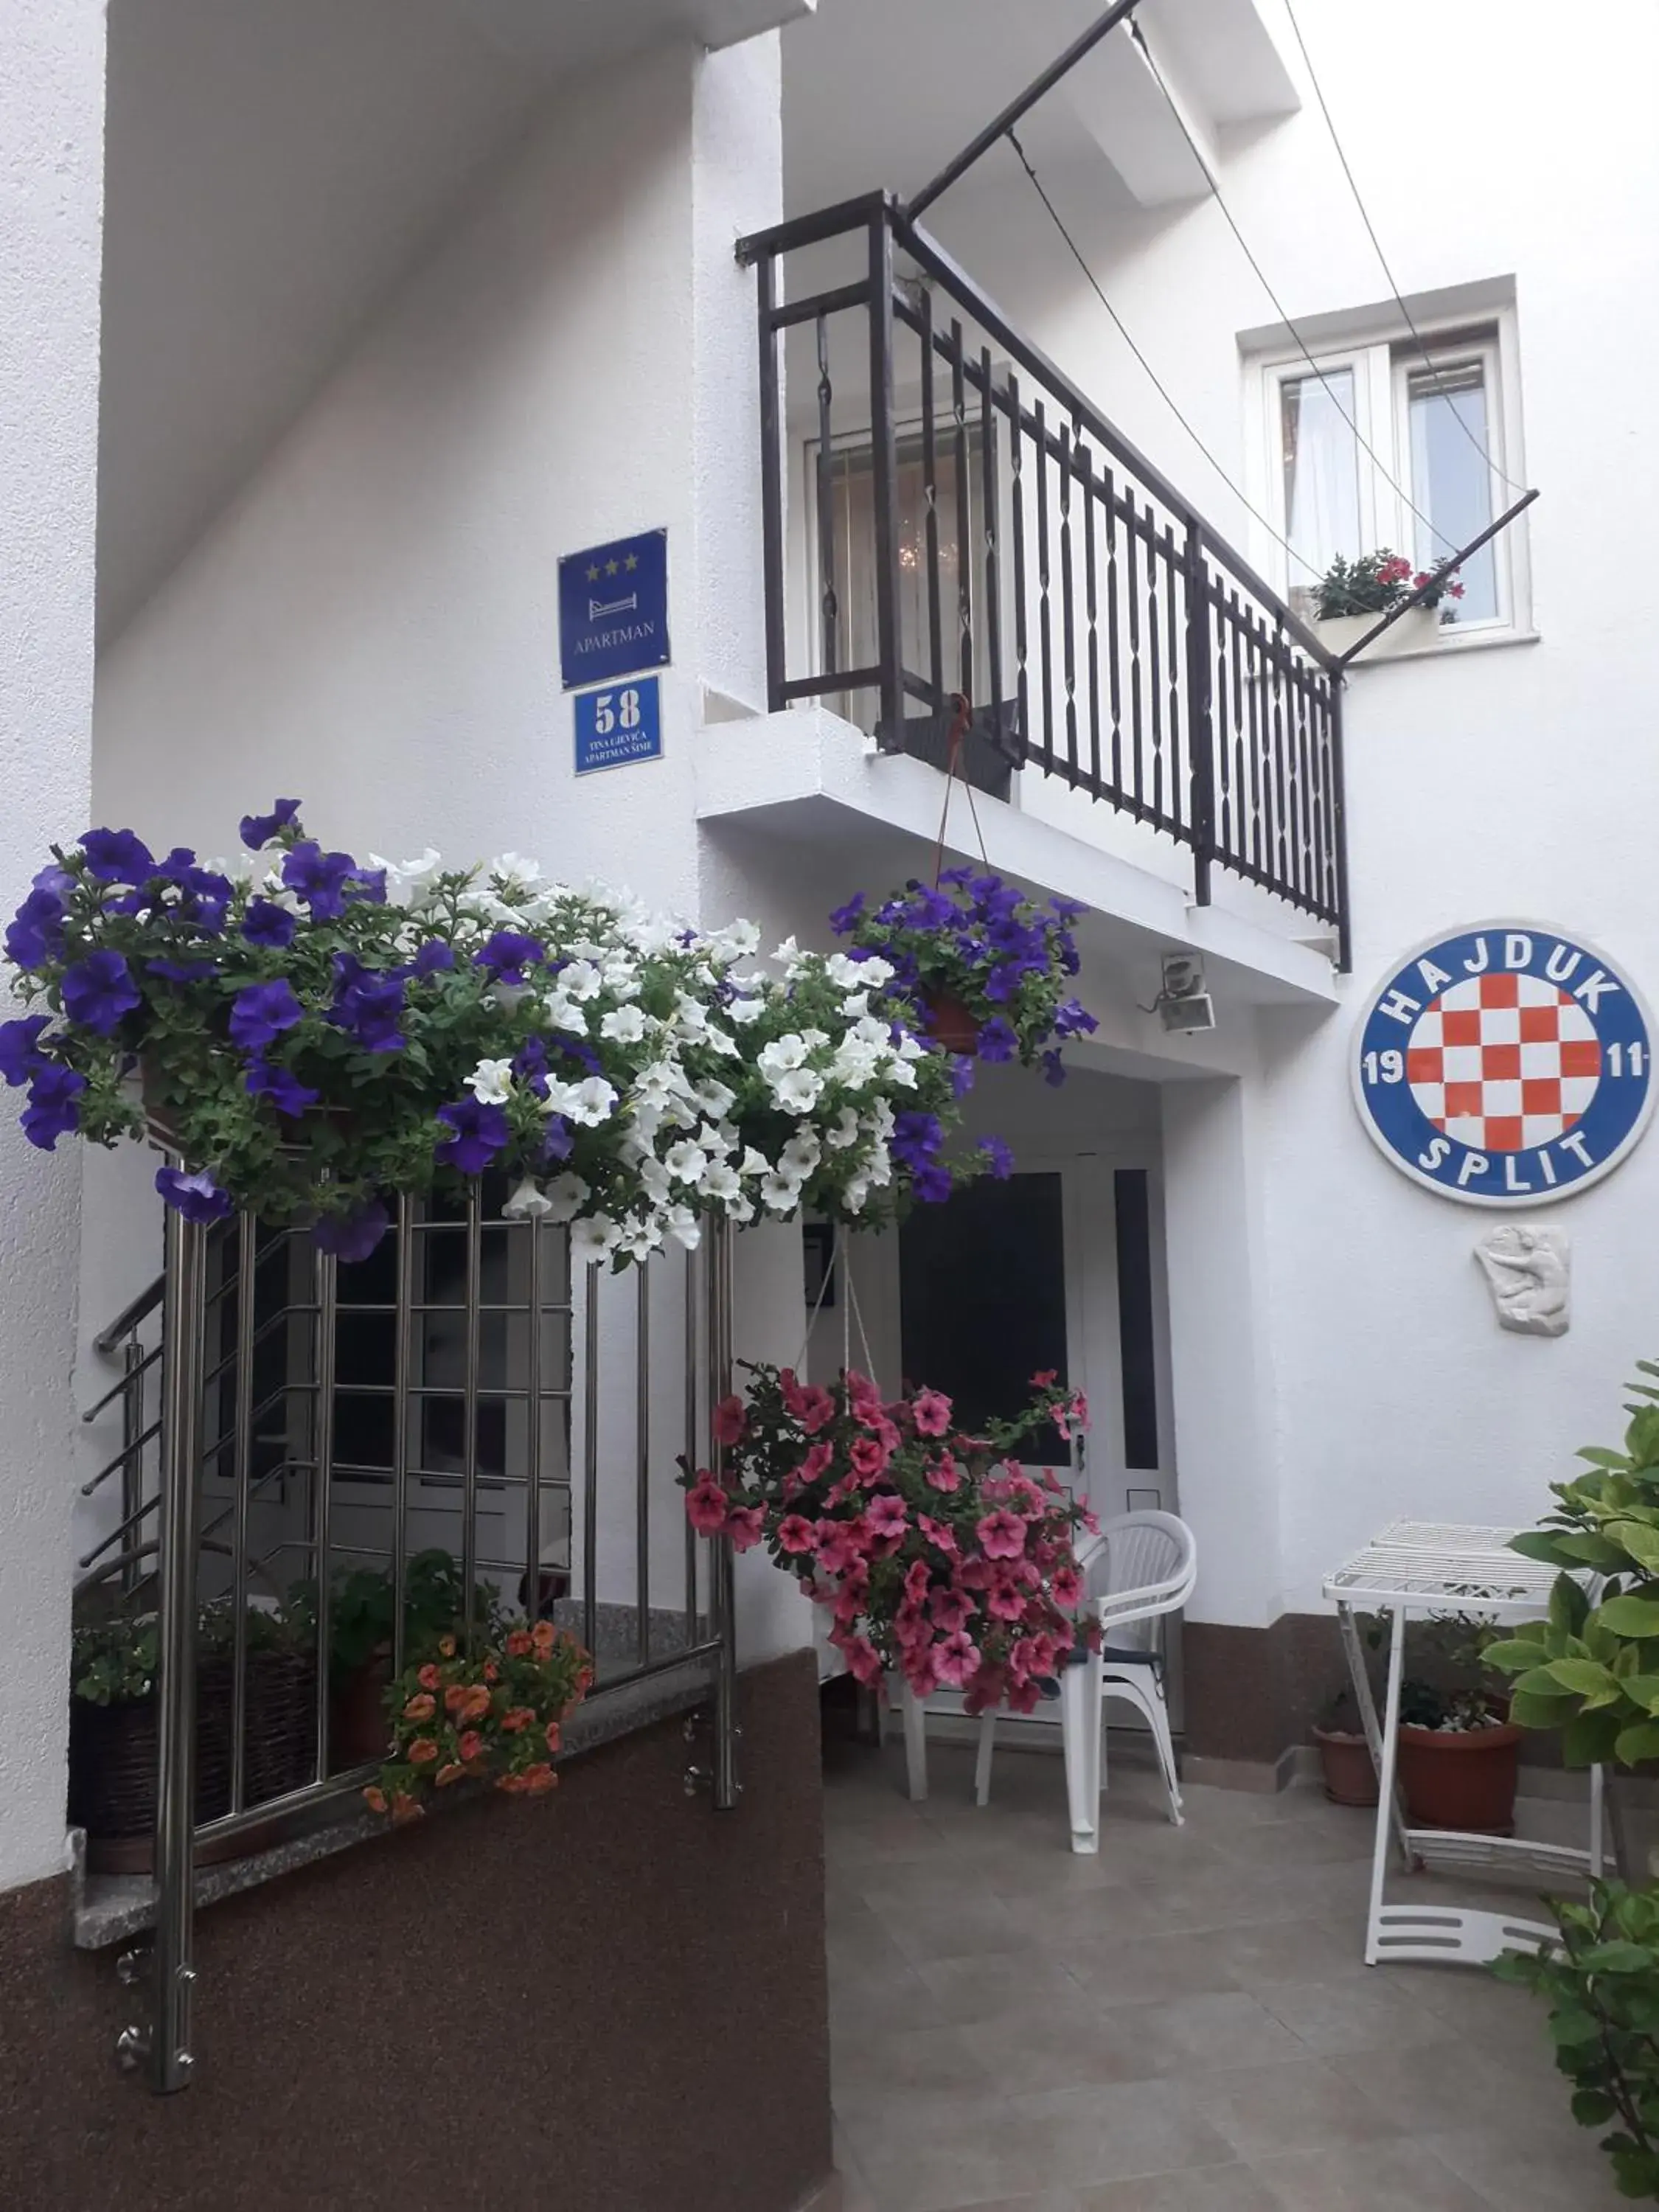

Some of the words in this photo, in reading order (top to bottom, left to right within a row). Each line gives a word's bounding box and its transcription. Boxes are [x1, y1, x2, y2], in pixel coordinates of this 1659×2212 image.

[574, 621, 655, 655] APARTMAN
[596, 689, 640, 734] 58
[585, 748, 630, 763] APARTMAN
[1378, 933, 1621, 1026] HAJDUK
[1363, 1049, 1404, 1085] 19
[1607, 1041, 1643, 1077] 11
[1418, 1130, 1595, 1191] SPLIT
